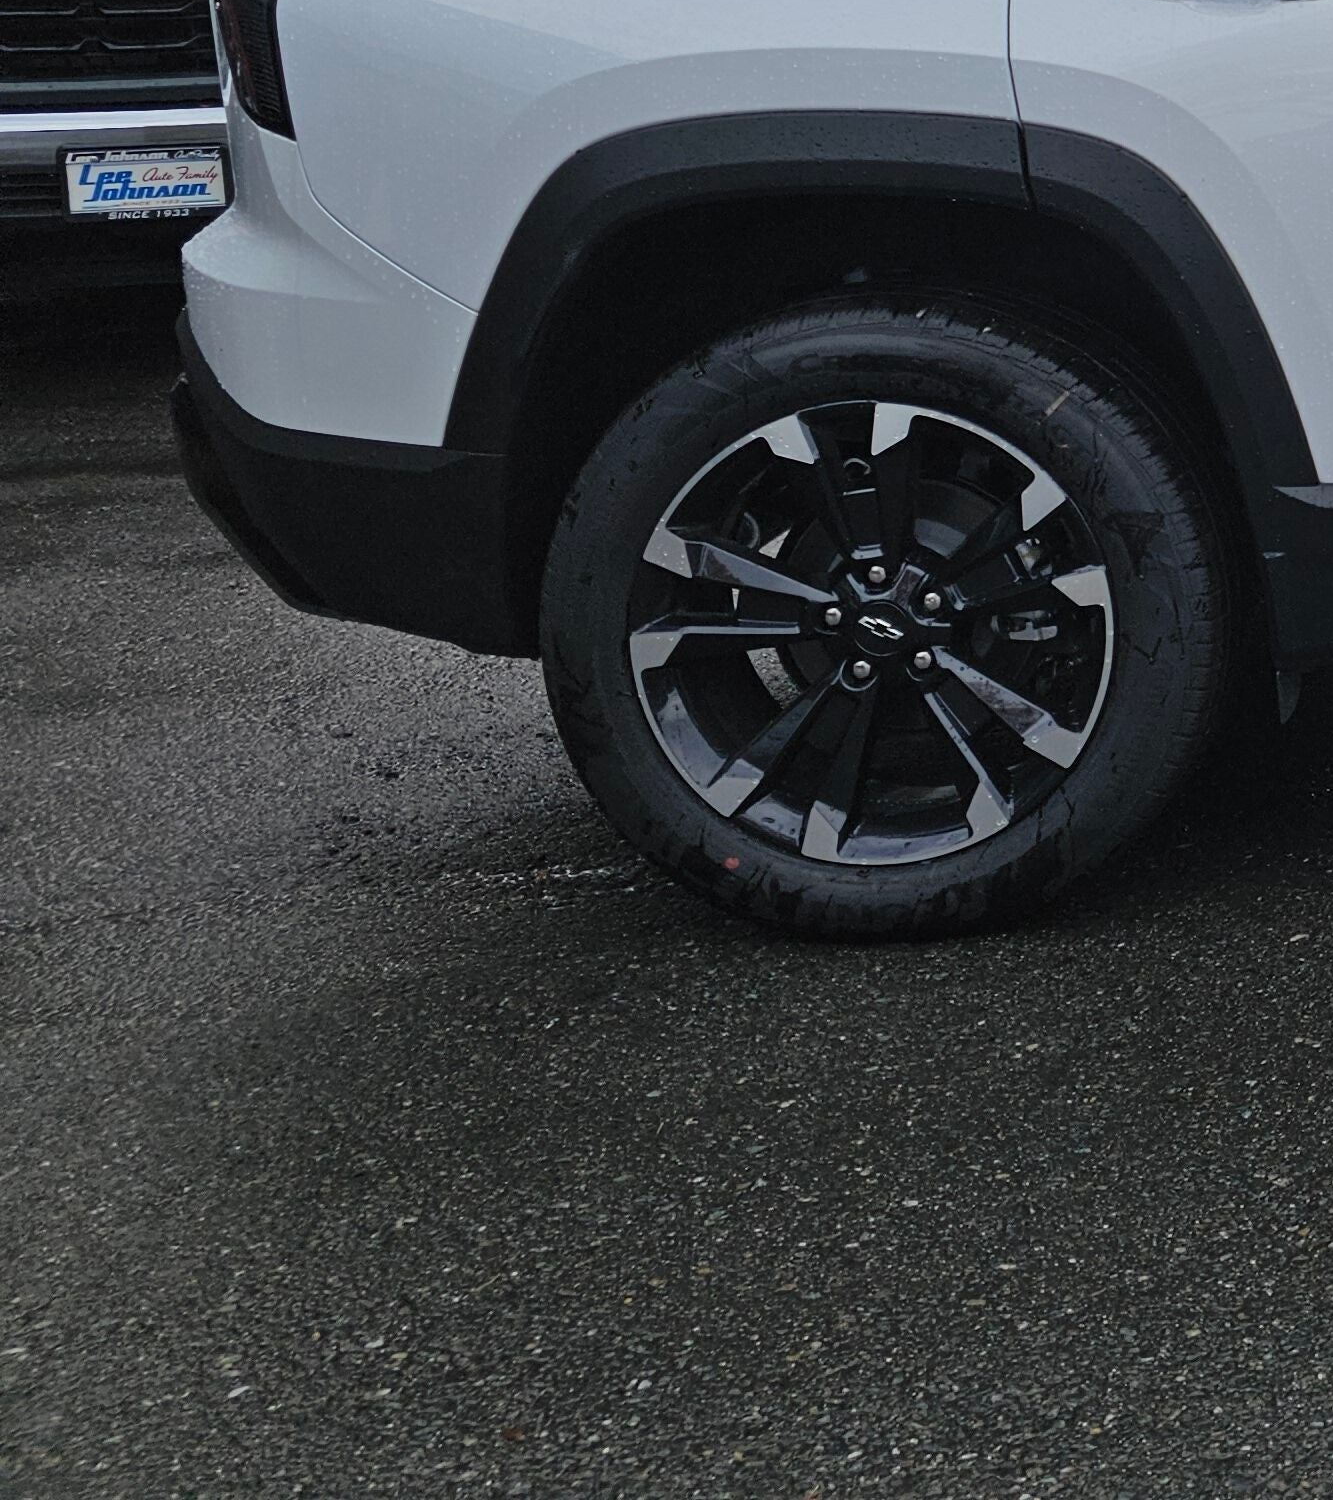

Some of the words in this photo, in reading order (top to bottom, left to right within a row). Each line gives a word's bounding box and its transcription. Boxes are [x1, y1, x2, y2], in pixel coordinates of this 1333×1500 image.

[103, 150, 170, 162] Johnson
[79, 164, 136, 185] Lee
[142, 167, 174, 182] Auto
[176, 165, 218, 184] Family
[84, 181, 211, 202] Johnson
[108, 211, 150, 220] SINCE
[156, 209, 190, 218] 1933
